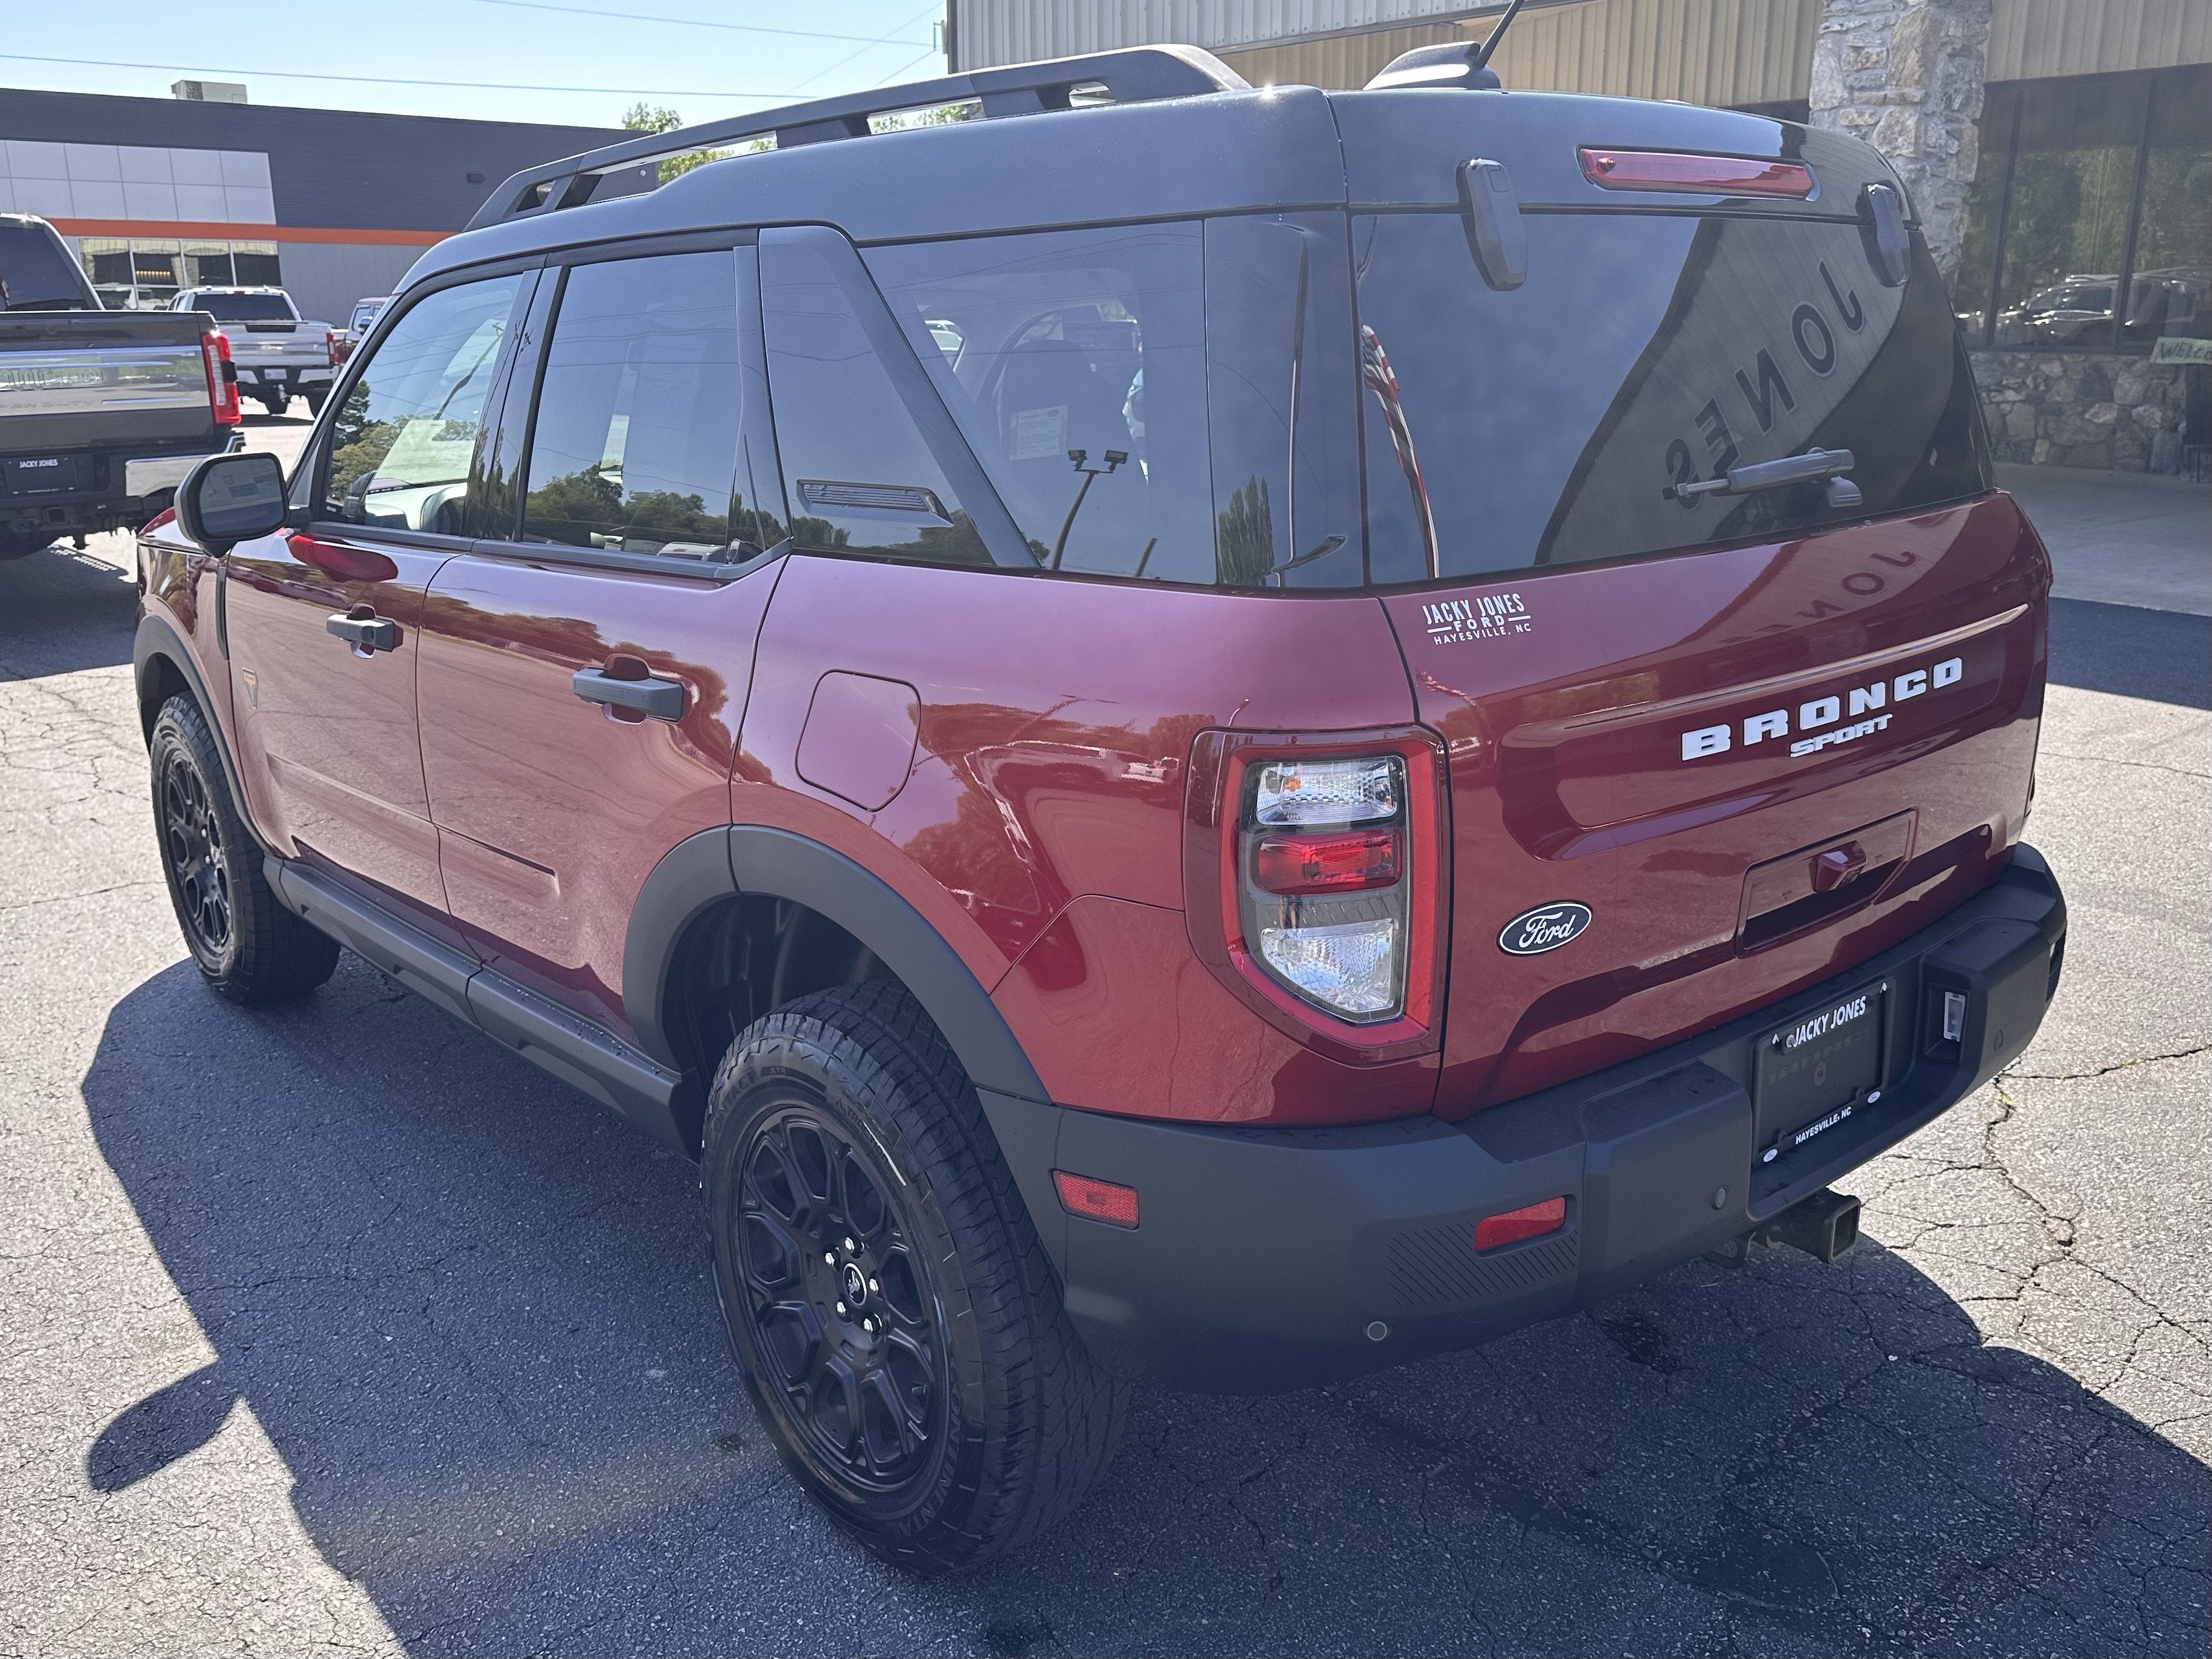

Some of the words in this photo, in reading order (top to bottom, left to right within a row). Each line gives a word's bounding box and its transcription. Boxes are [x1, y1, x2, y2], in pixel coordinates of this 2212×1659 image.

[1422, 599, 1473, 625] JACKY
[1477, 593, 1524, 617] JONES
[1453, 615, 1505, 631] FORD
[1434, 626, 1511, 645] HAYESVILLE,
[1515, 623, 1532, 633] NC
[1681, 657, 1962, 761] BRONCO
[1790, 713, 1893, 757] SPORT
[1519, 911, 1576, 948] Ford
[1793, 1013, 1829, 1048] JACKY
[1830, 996, 1866, 1029] JONES
[1795, 1113, 1840, 1145] HAYESVILLE,
[1841, 1106, 1851, 1119] NC
